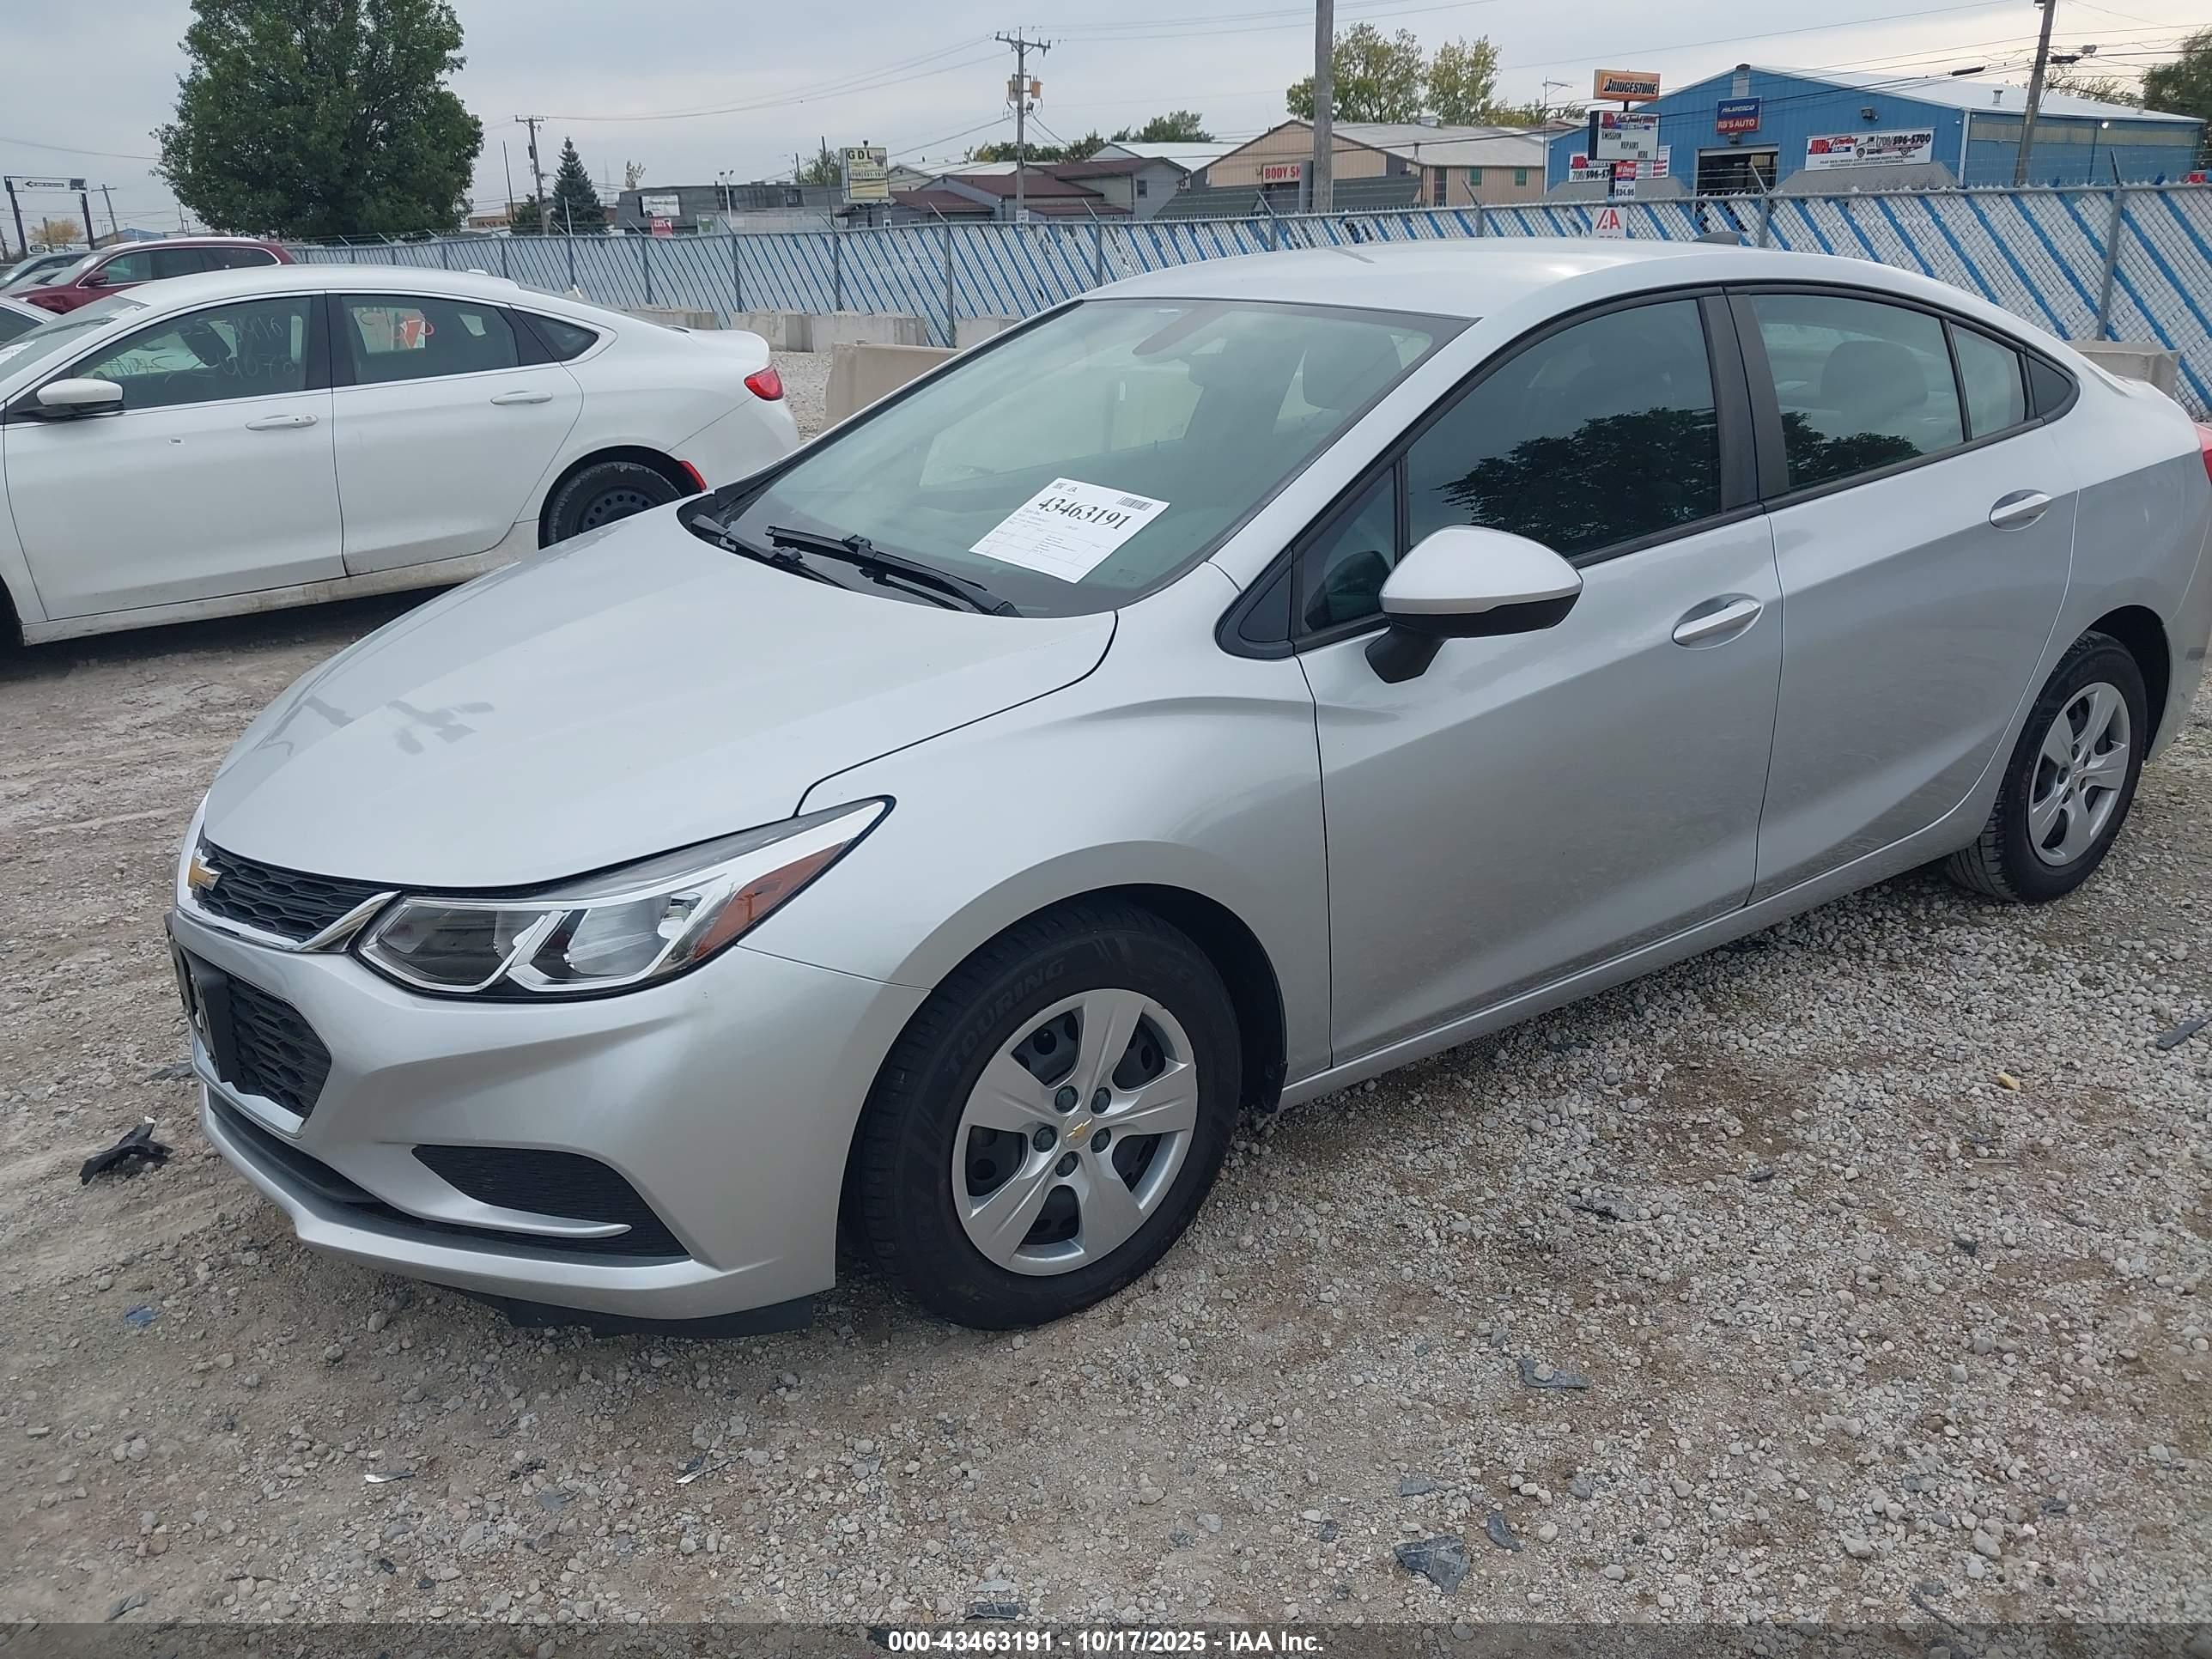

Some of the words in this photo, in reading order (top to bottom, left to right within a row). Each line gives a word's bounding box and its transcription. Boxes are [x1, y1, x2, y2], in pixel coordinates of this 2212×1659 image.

[1603, 78, 1657, 94] BRIDGESTONE
[1735, 118, 1755, 129] AUTO
[1601, 131, 1622, 140] EMISSION
[1620, 141, 1639, 149] REPAIRS
[1265, 167, 1287, 179] BODY
[1038, 496, 1132, 531] 43463191
[945, 957, 1066, 1073] TOURING
